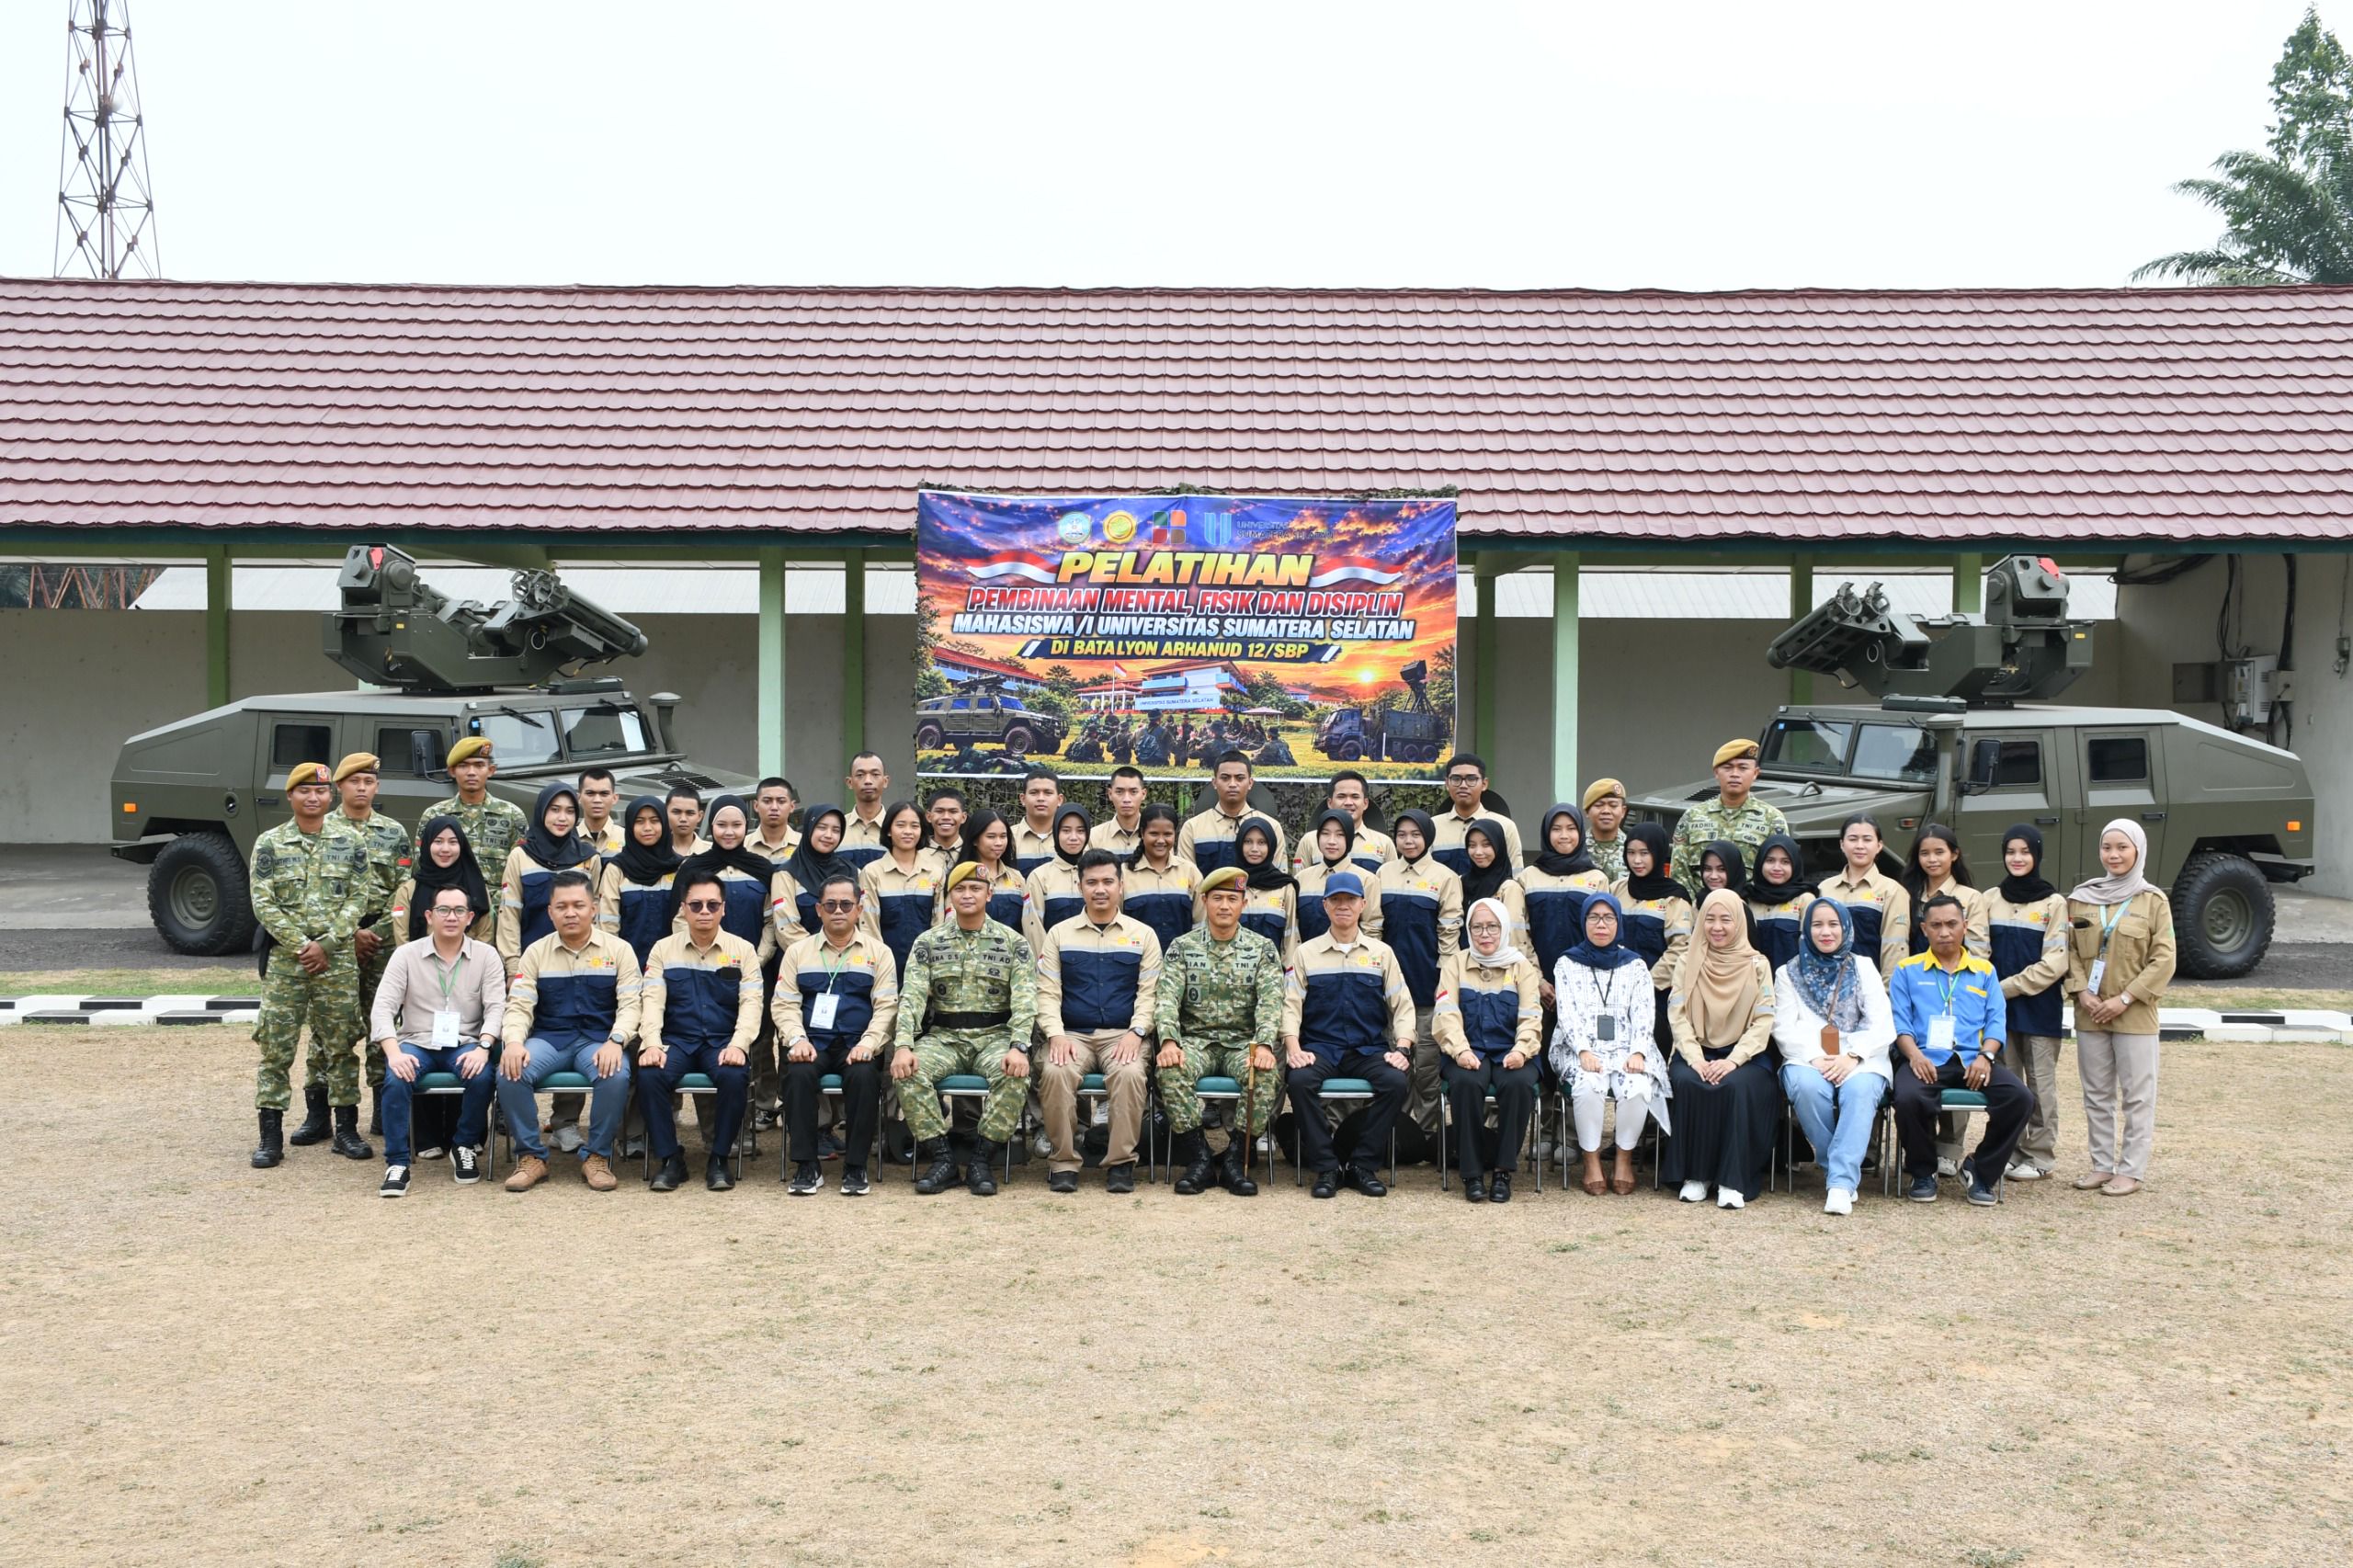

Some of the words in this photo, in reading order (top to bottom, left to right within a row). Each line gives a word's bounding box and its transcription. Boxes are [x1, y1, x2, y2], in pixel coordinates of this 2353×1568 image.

[1236, 530, 1292, 539] SUMATERA
[1057, 552, 1313, 586] PELATIHAN
[967, 586, 1101, 614] PEMBINAAN
[1102, 587, 1194, 618] MENTAL,
[1197, 589, 1256, 617] FISIK
[1256, 591, 1304, 618] DAN
[1305, 592, 1404, 619] DISIPLIN
[1097, 616, 1220, 638] UNIVERSITAS
[1223, 619, 1324, 639] SUMATERA
[1330, 619, 1415, 640] SELATAN
[1051, 640, 1069, 654] DI
[1073, 641, 1159, 656] BATALYON
[1160, 642, 1243, 658] ARHANUD
[1247, 642, 1309, 659] 12/SBP
[999, 956, 1011, 964] AD
